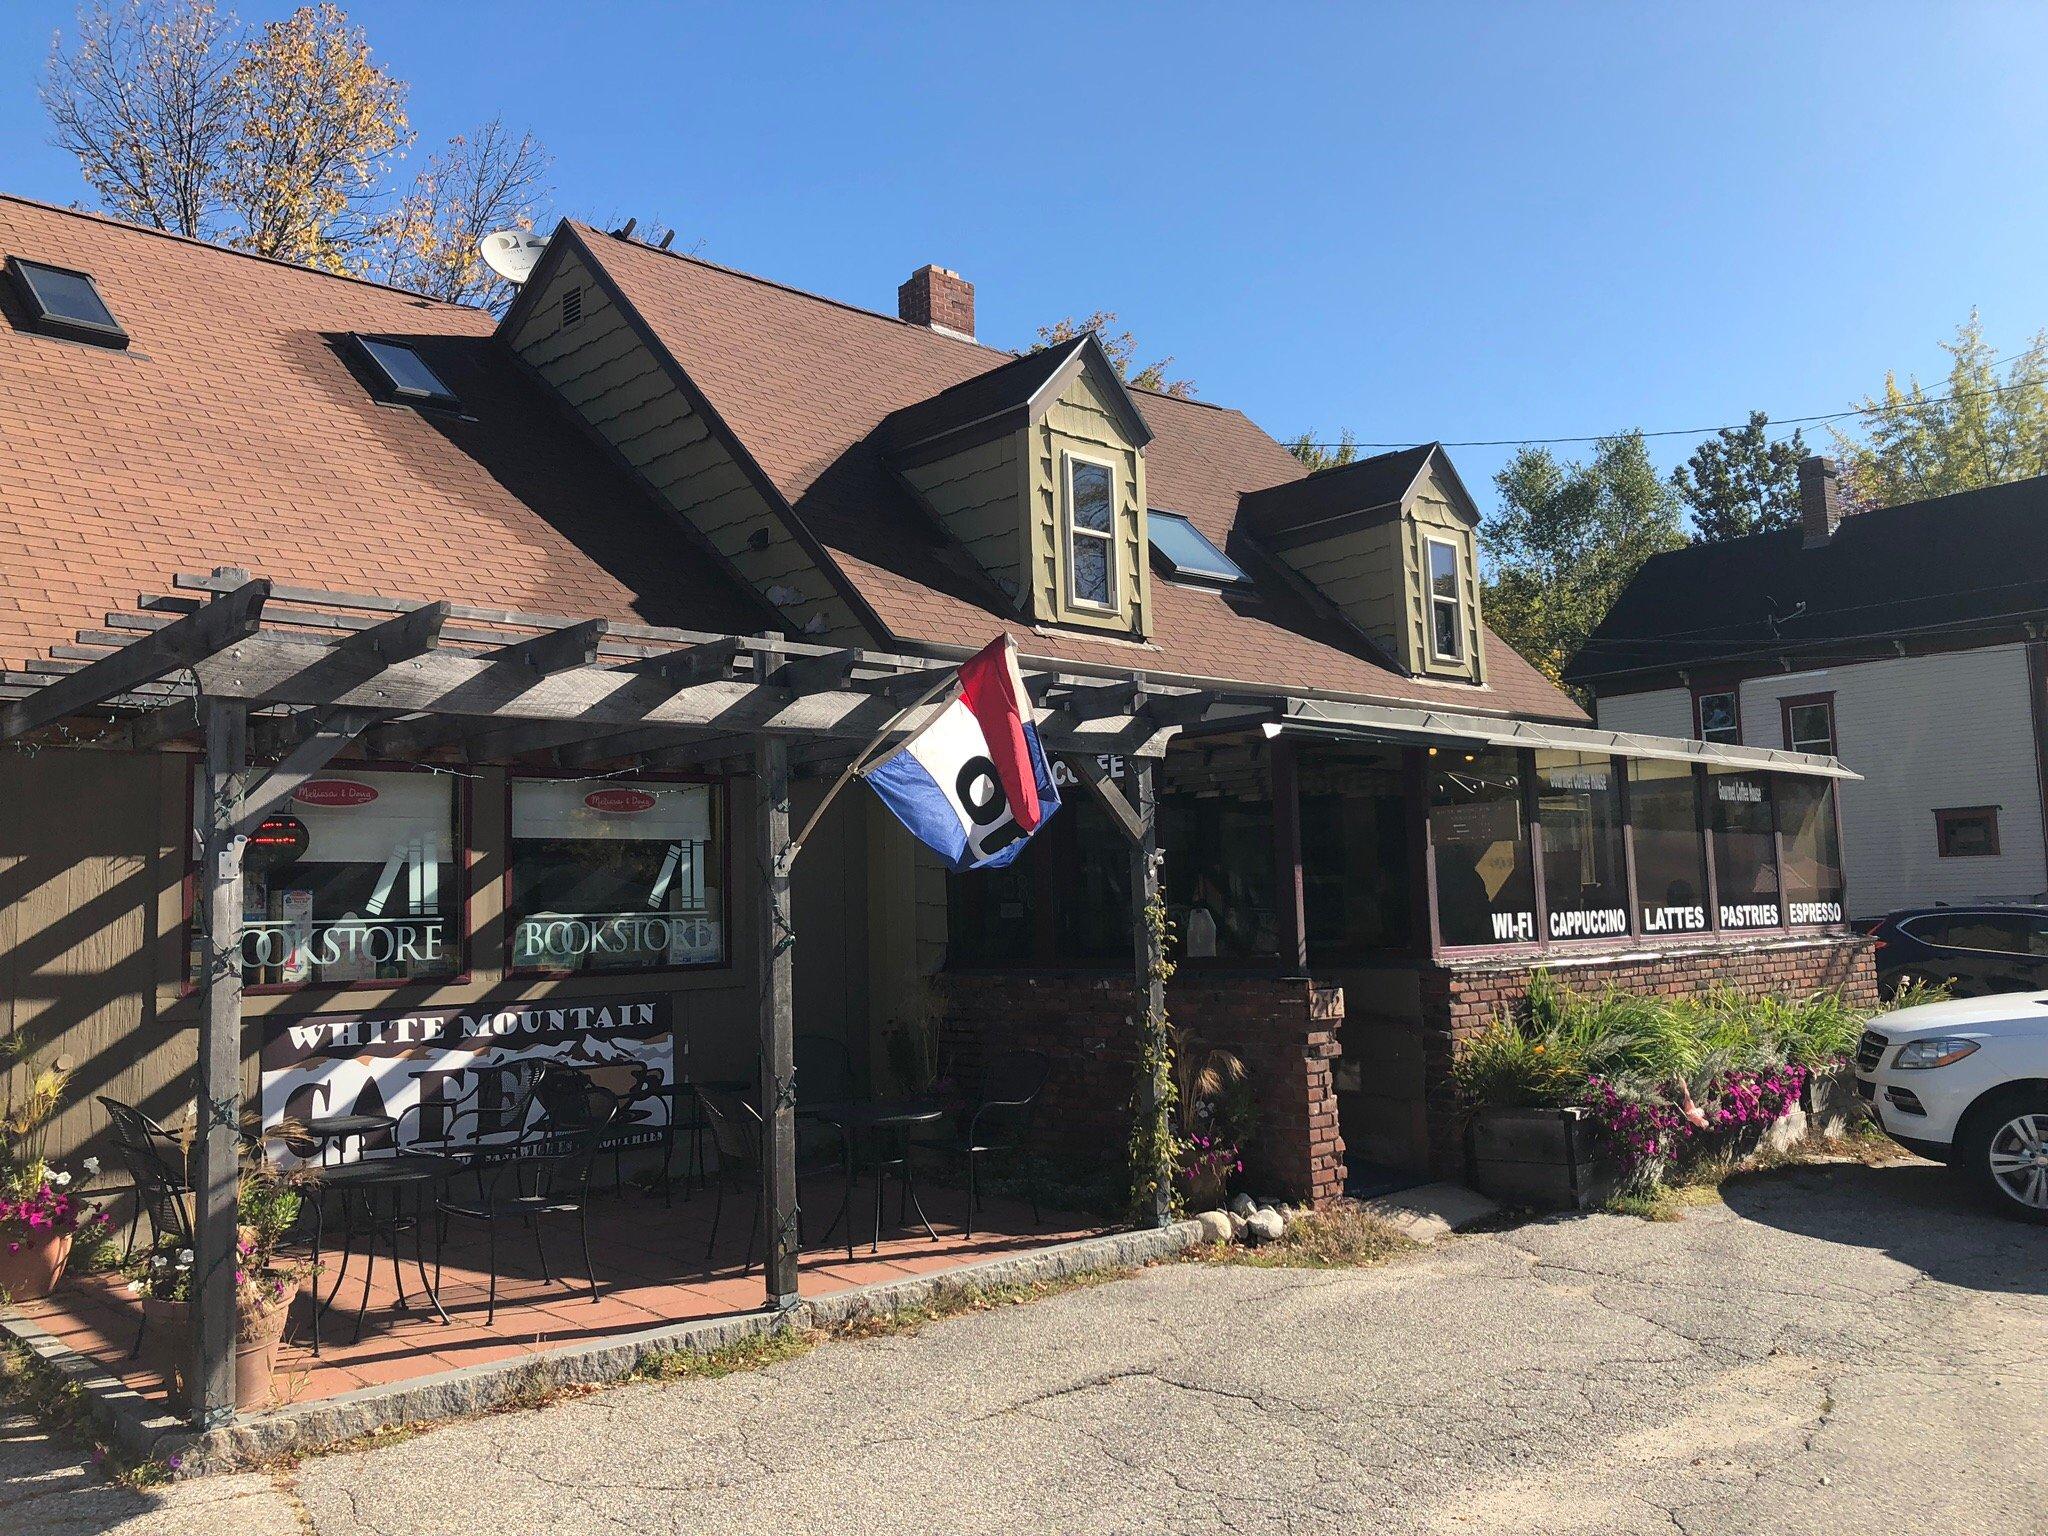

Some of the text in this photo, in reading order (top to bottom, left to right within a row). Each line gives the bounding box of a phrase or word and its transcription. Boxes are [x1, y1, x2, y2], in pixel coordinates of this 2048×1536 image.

[298, 788, 338, 800] Melissa
[1718, 780, 1761, 802] Gourmet Coffee House
[1491, 912, 1533, 939] WI-FI
[1550, 908, 1626, 937] CAPPUCCINO
[1644, 906, 1705, 931] LATTES
[1720, 904, 1779, 927] PASTRIES
[1789, 902, 1841, 923] ESPRESSO
[240, 924, 444, 969] OOKSTORE
[523, 918, 709, 957] BOOKSTORE
[287, 1002, 657, 1050] WHITE MOUNTAIN
